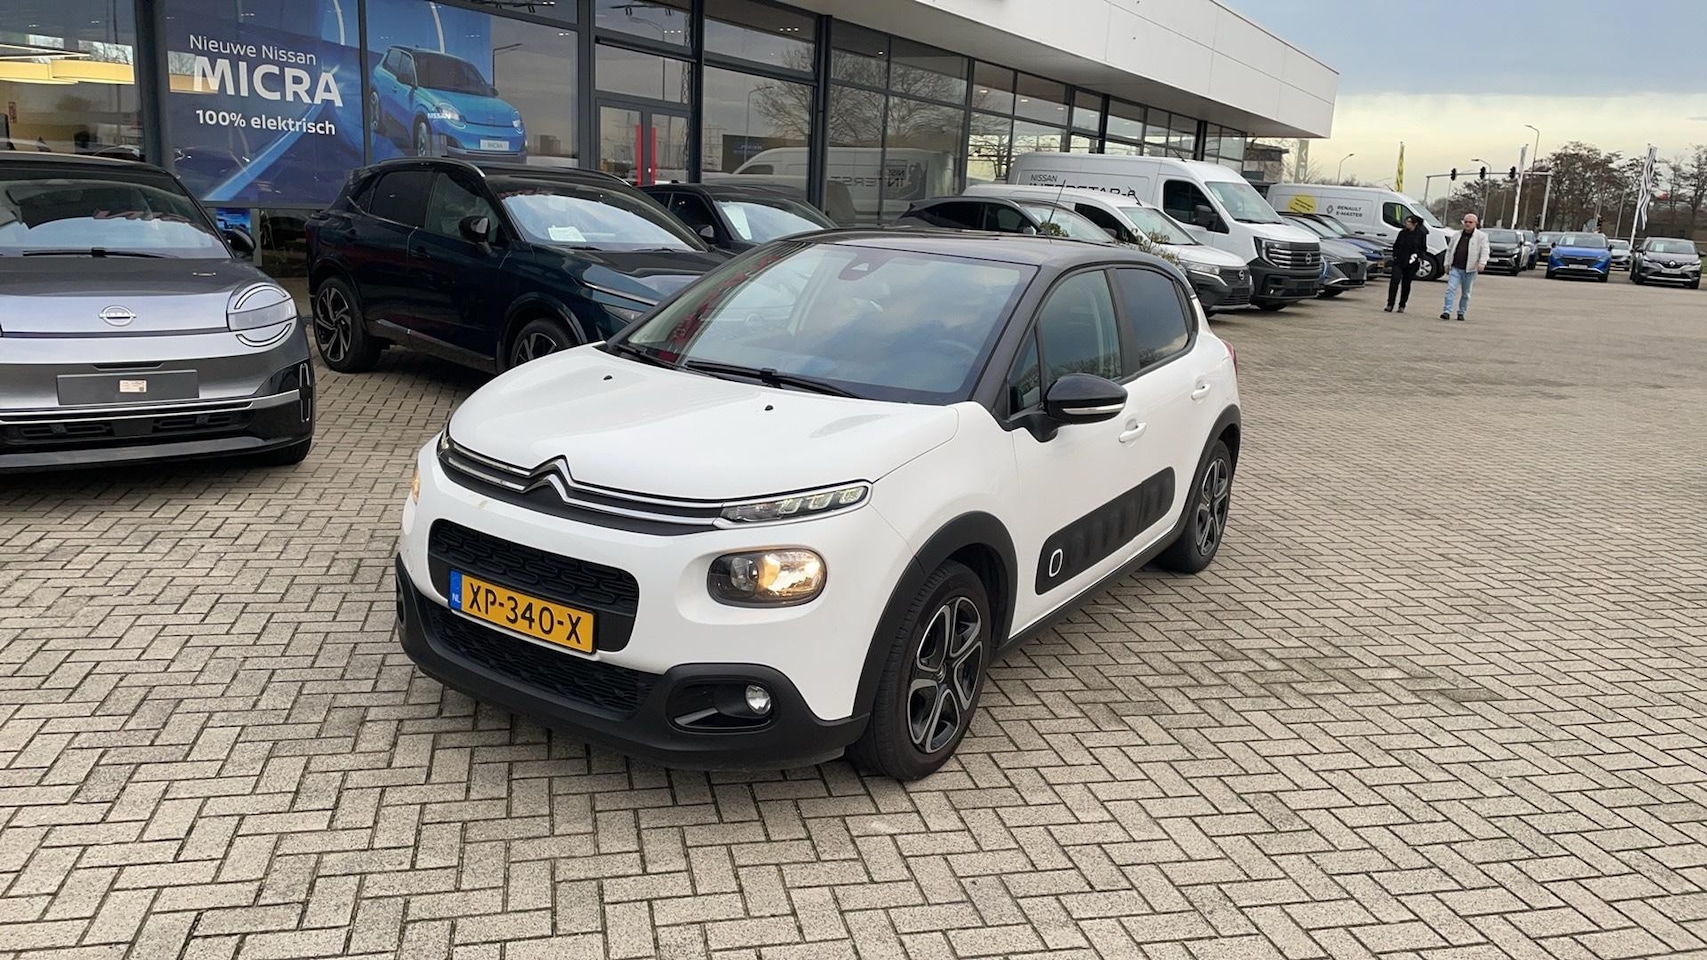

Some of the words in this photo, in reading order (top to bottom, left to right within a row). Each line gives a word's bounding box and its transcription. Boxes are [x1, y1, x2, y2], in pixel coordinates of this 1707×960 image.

[189, 34, 257, 58] Nieuwe
[261, 44, 317, 66] Nissan
[193, 55, 343, 107] MICRA
[196, 109, 247, 128] 100%
[250, 114, 336, 135] elektrisch
[1031, 174, 1058, 182] NISSAN
[451, 593, 461, 603] NL
[469, 583, 582, 644] XP-340-X
